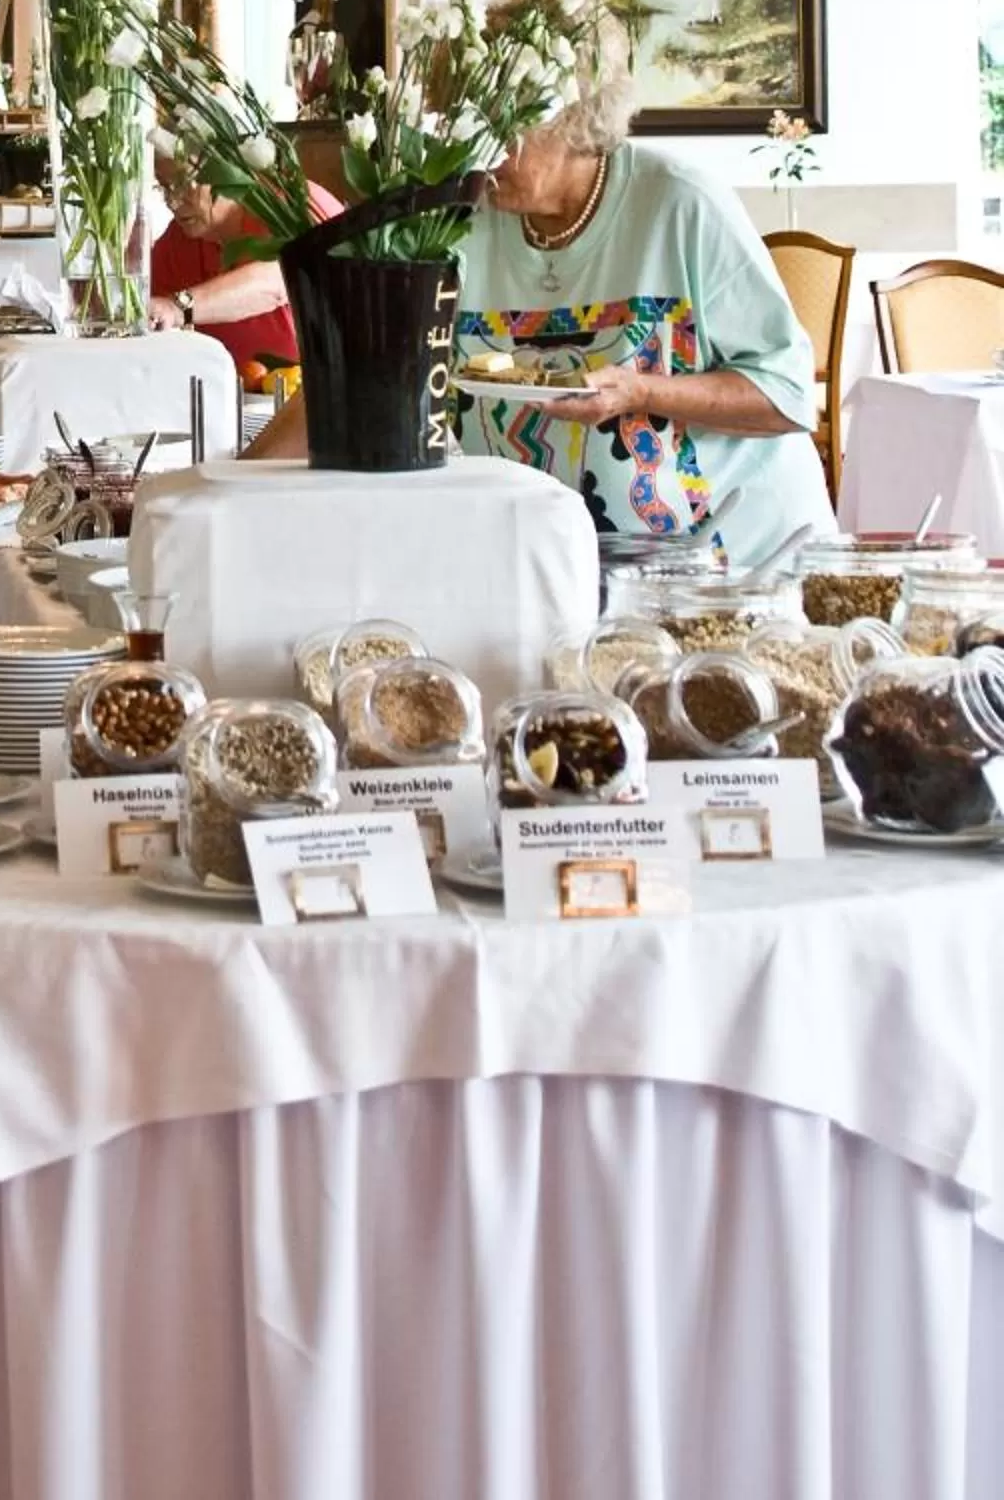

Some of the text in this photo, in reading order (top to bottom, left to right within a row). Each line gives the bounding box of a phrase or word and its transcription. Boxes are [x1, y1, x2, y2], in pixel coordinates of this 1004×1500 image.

[427, 279, 460, 449] MOËT
[349, 776, 454, 797] Weizenkleie
[682, 771, 779, 787] Leinsamen
[92, 786, 175, 803] Haselnüs
[519, 818, 666, 837] Studentenfutter
